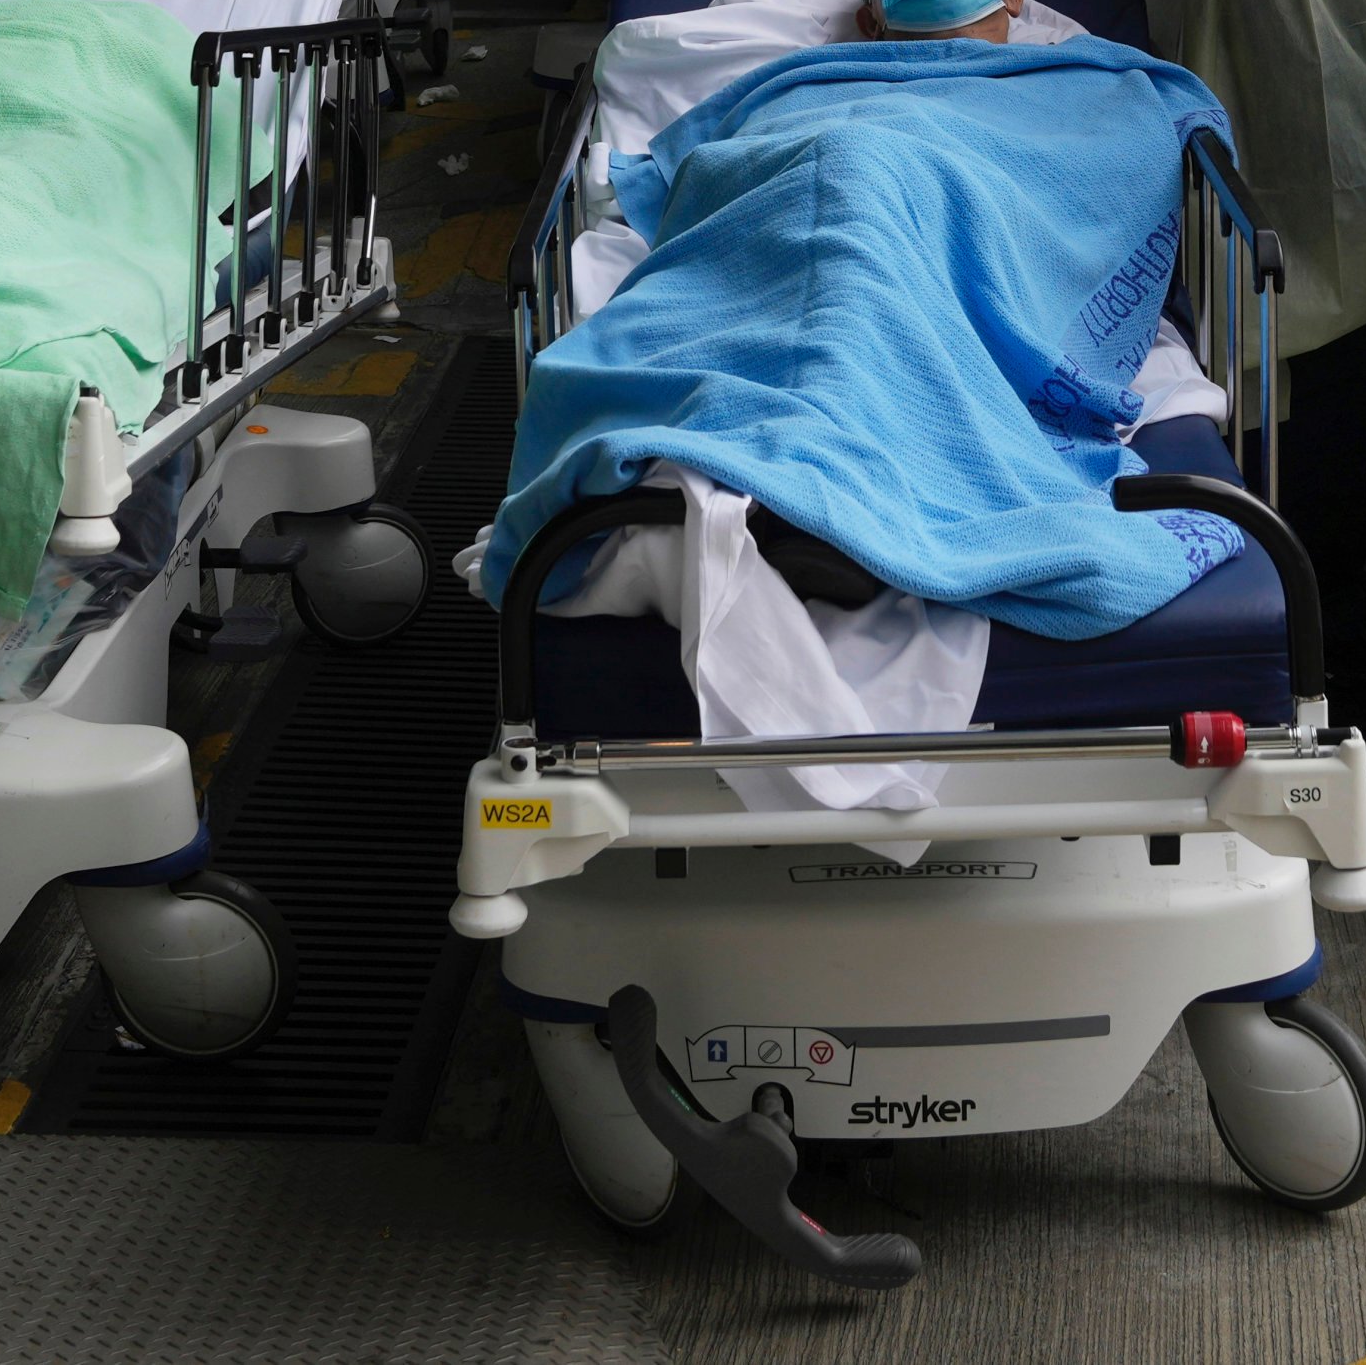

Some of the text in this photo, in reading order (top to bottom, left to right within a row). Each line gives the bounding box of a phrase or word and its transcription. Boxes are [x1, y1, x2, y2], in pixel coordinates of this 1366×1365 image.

[1290, 787, 1321, 803] S30
[483, 804, 550, 823] WS2A
[820, 863, 1006, 878] TRANSPORT
[848, 1095, 976, 1128] stryker
